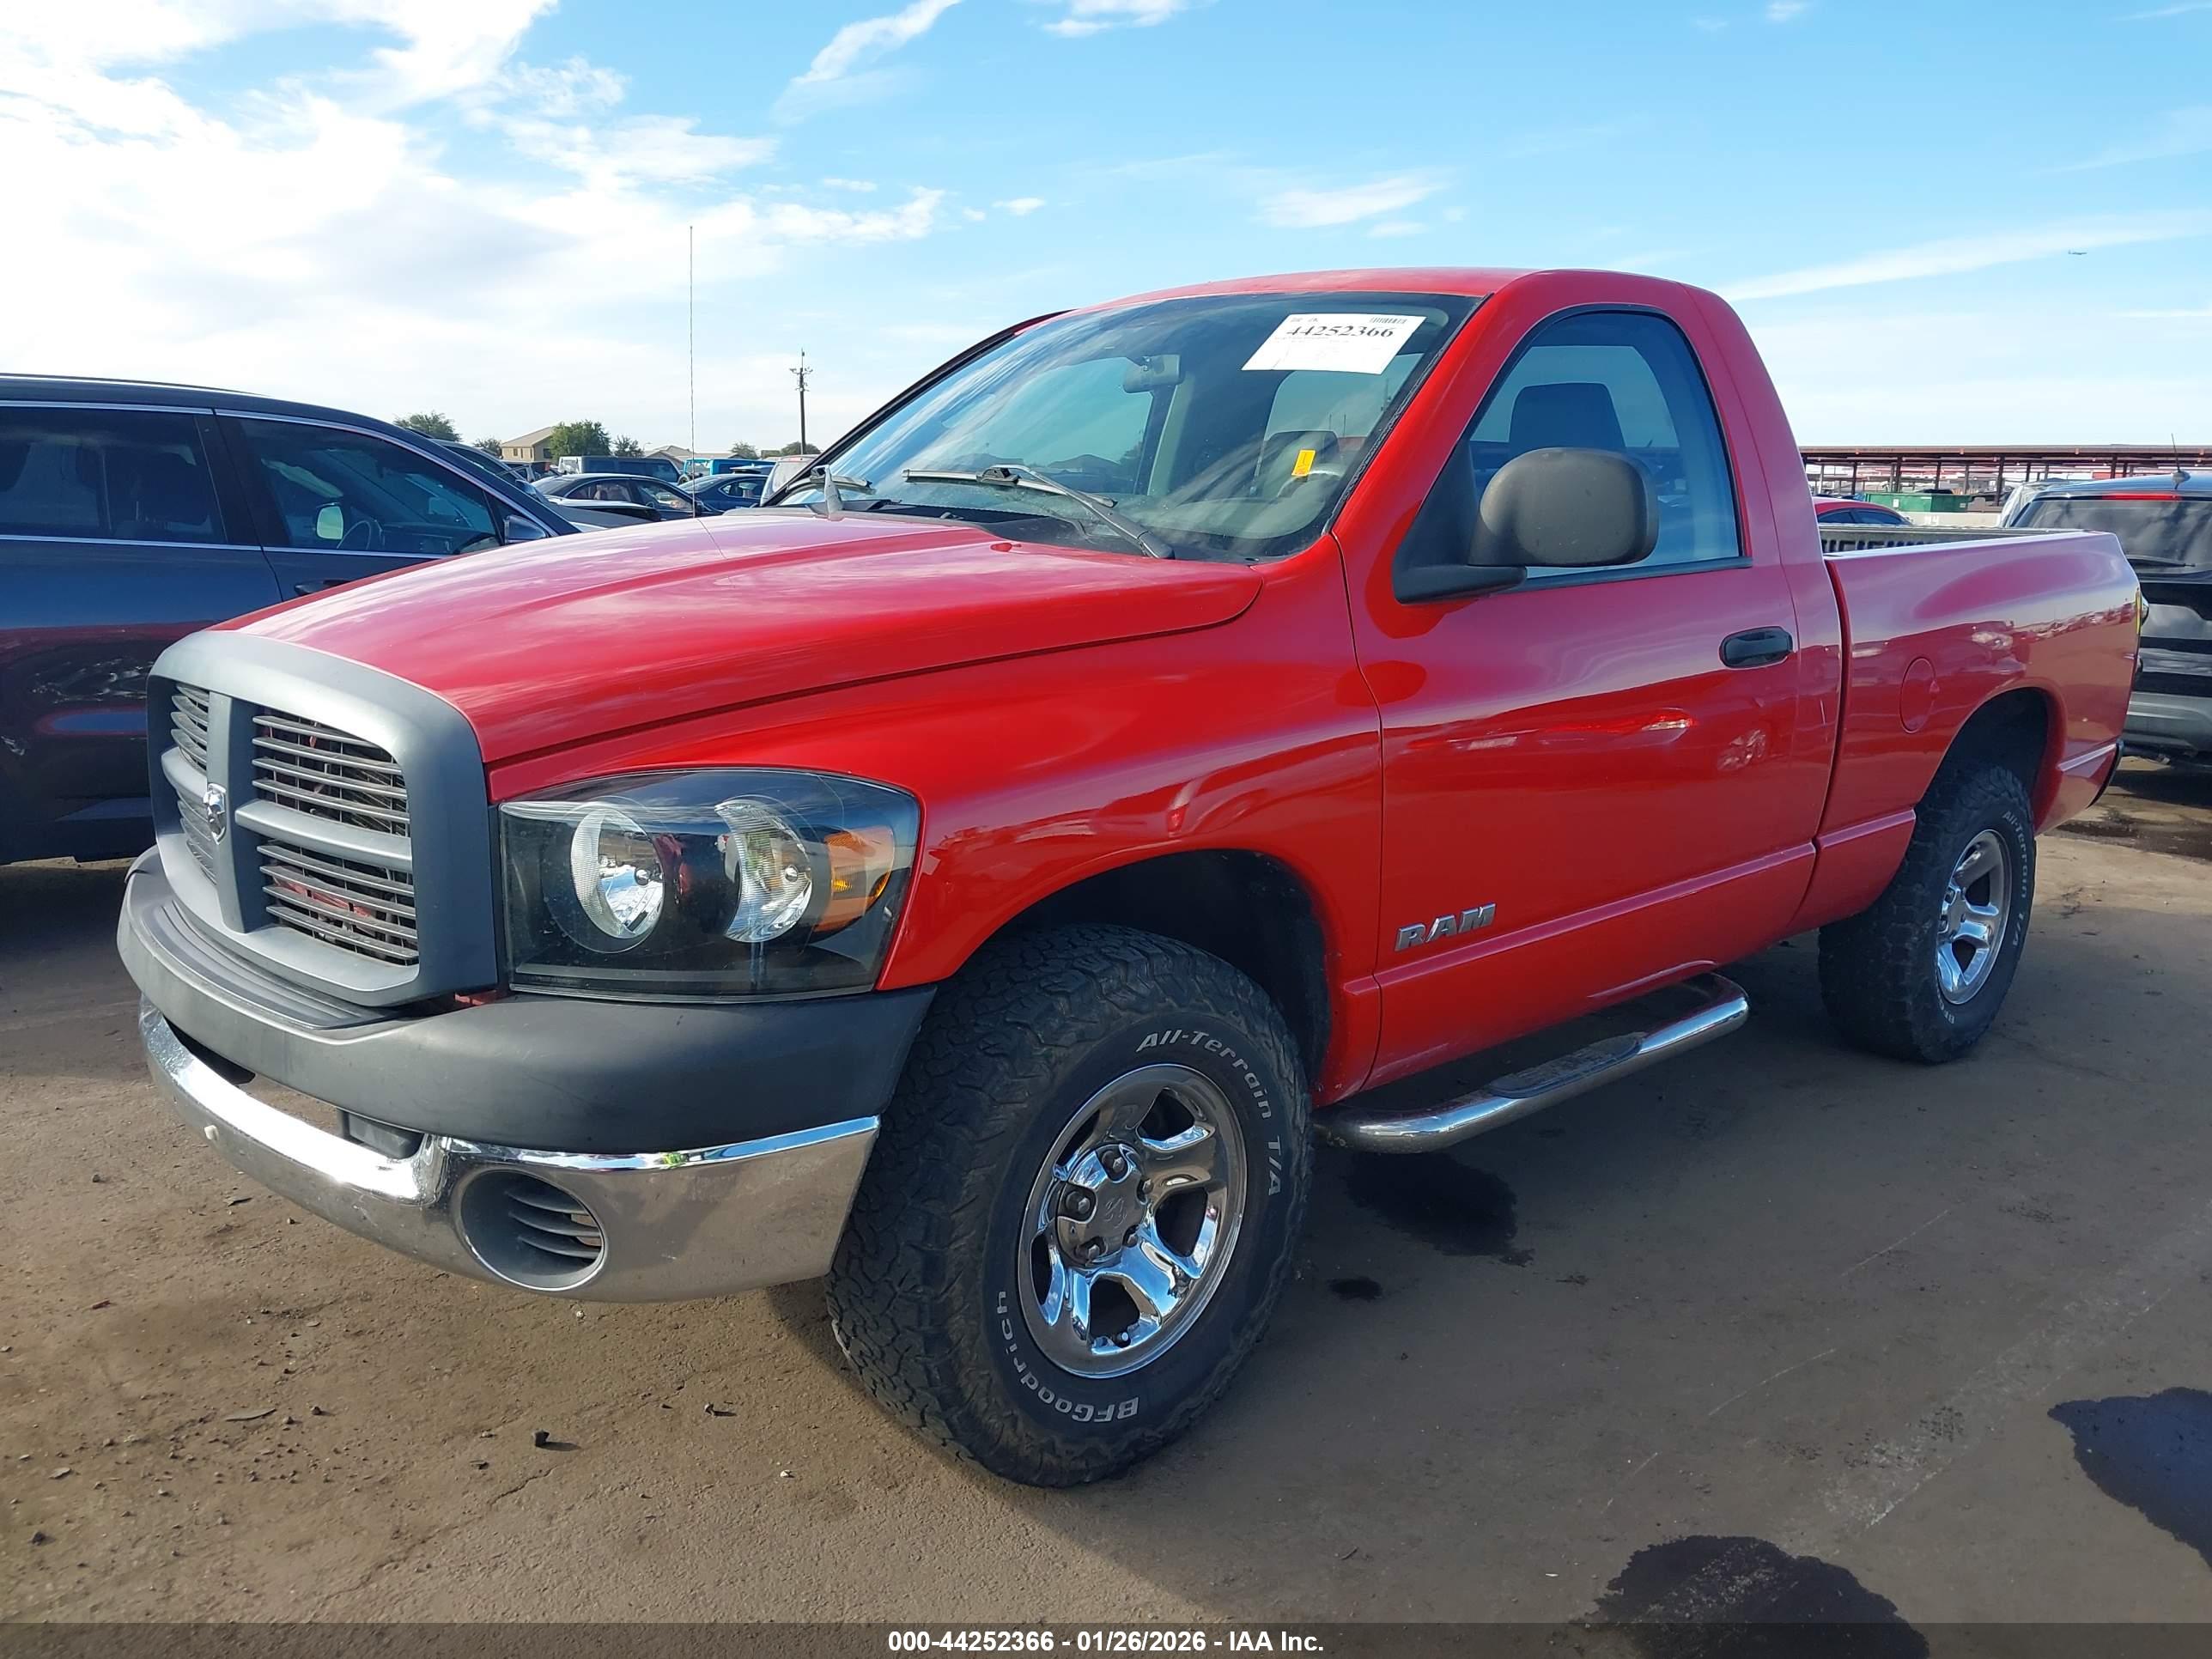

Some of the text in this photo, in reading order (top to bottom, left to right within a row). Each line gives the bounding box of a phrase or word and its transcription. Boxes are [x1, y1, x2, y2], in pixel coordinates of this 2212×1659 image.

[1286, 325, 1395, 337] 44252366
[1394, 902, 1496, 952] RAM
[1135, 1029, 1283, 1196] All-Terrain T/A
[996, 1291, 1140, 1423] BFGoodrich
